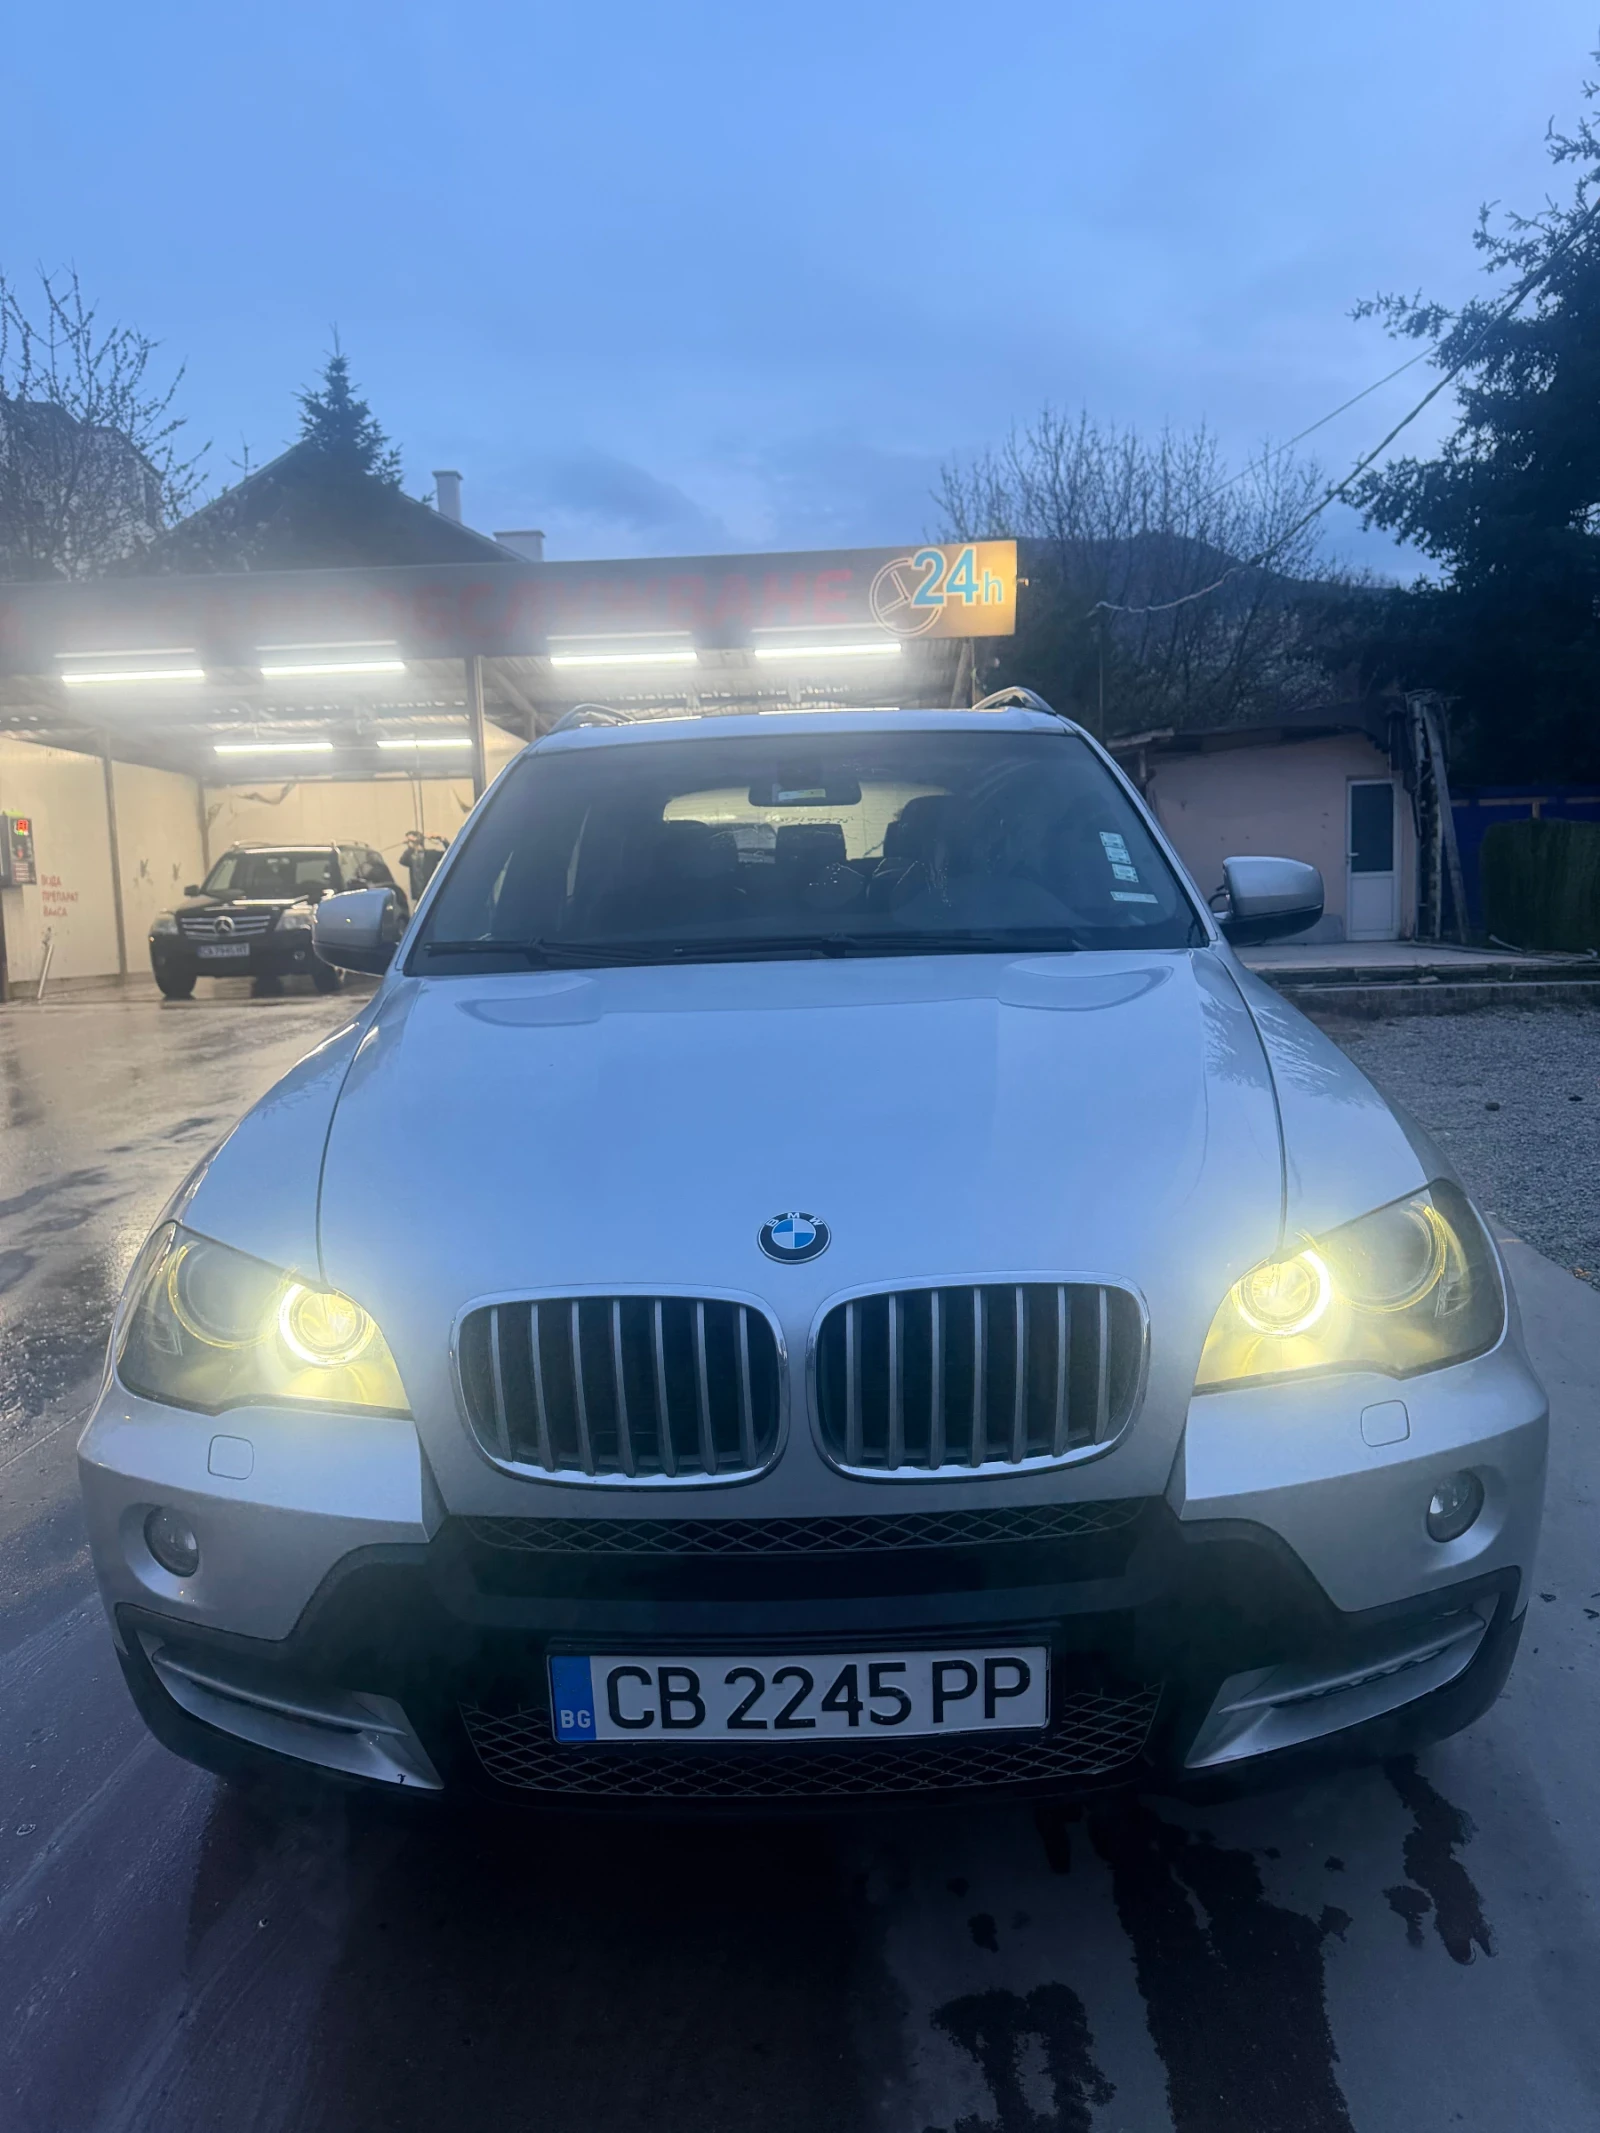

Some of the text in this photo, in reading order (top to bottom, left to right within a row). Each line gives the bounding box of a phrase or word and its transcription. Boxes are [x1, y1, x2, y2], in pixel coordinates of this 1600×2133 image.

[911, 545, 1004, 608] 24h
[765, 1212, 824, 1227] BMW
[606, 1657, 1032, 1730] CB 2245 PP
[561, 1708, 591, 1729] BG
